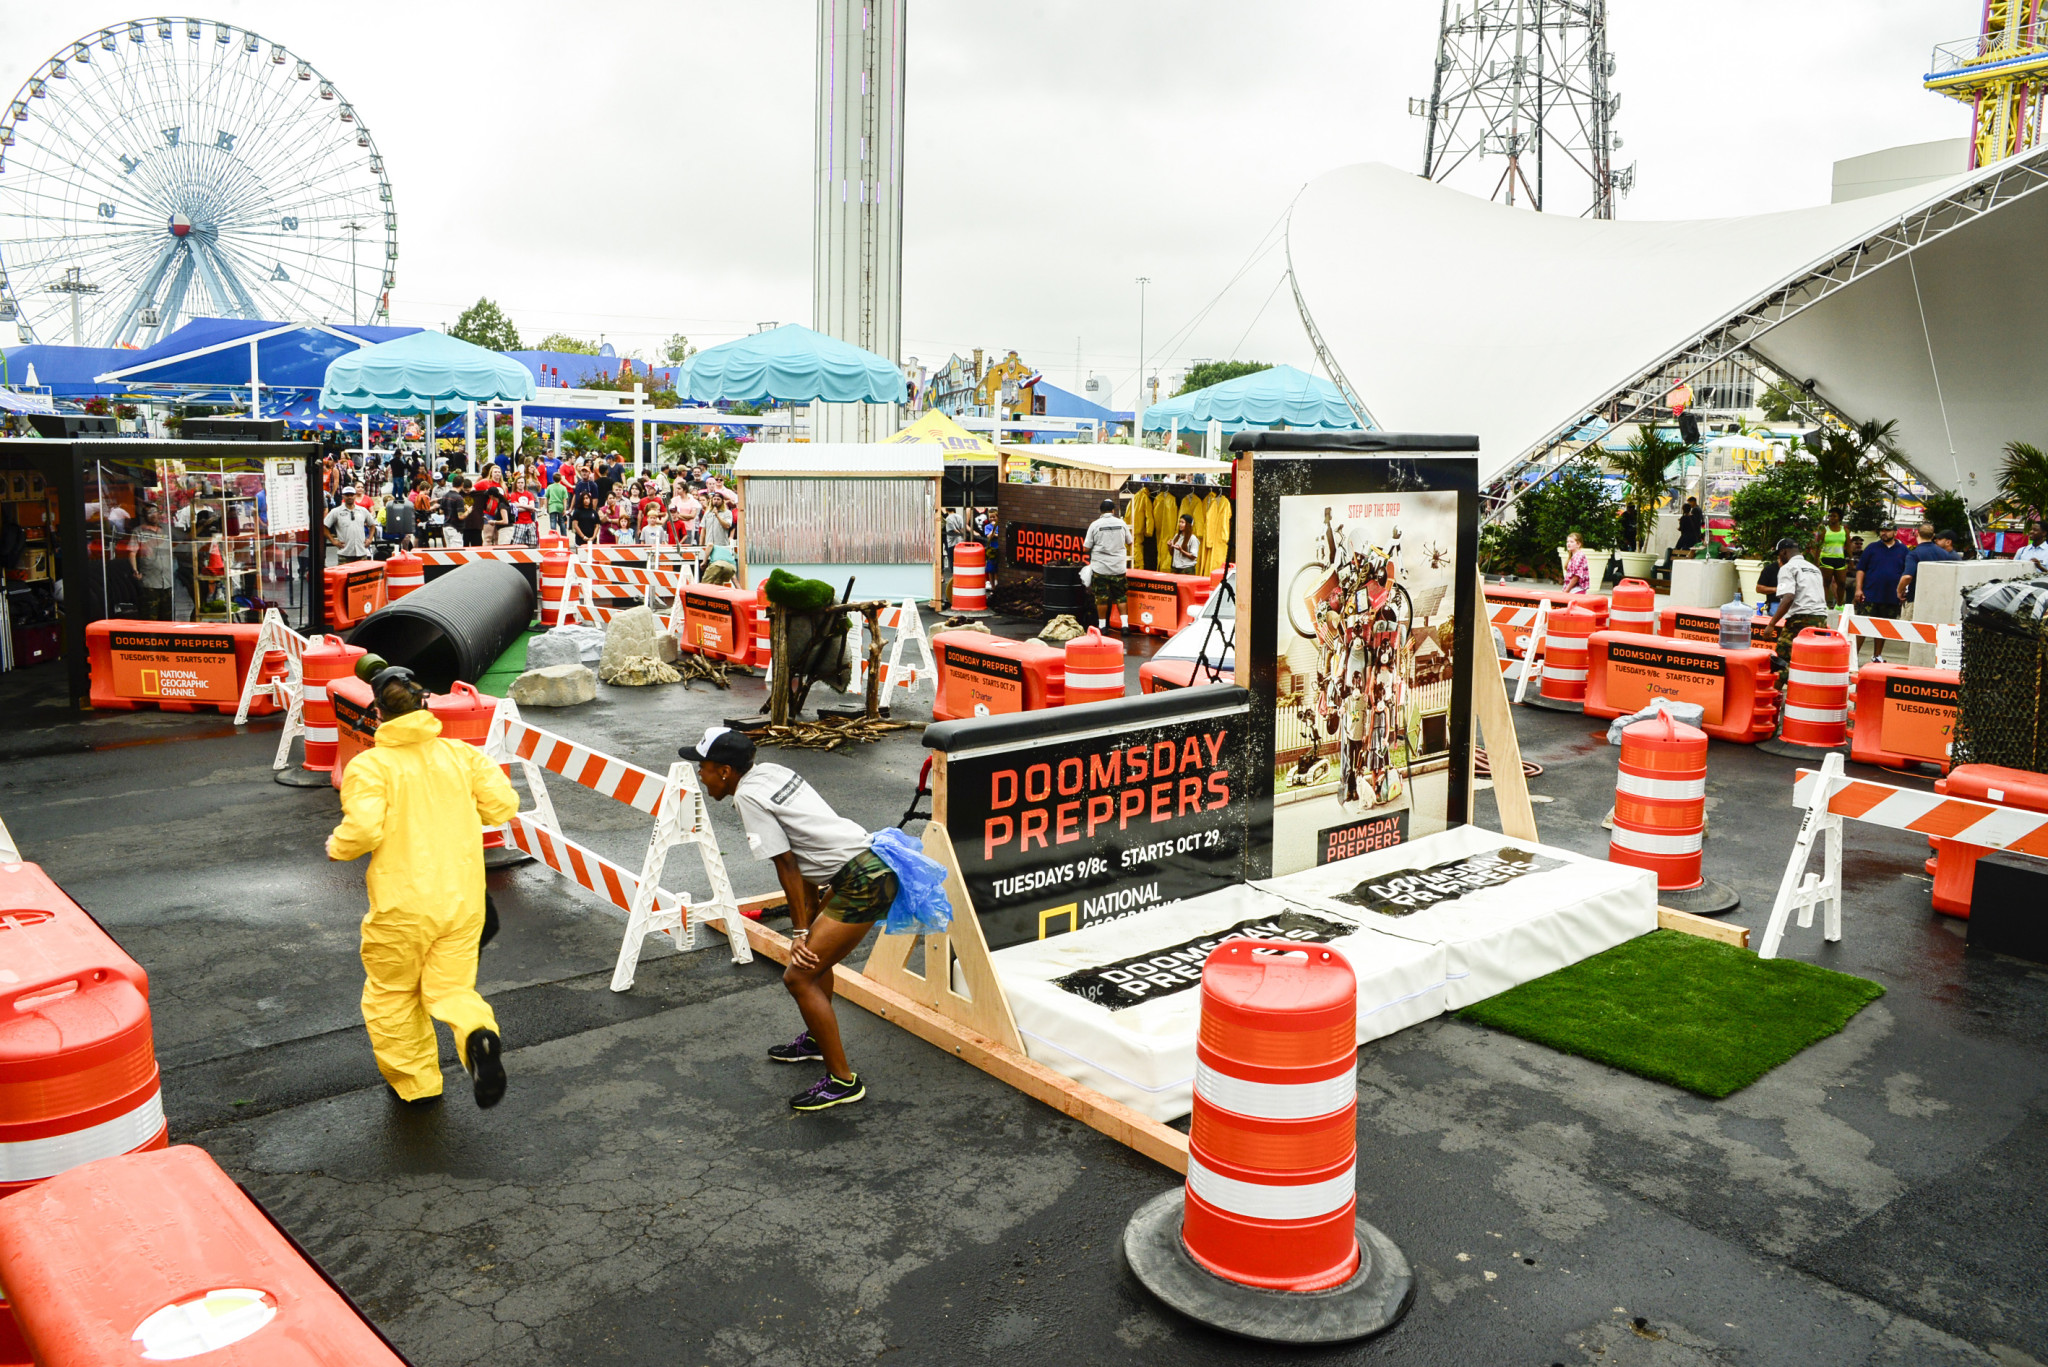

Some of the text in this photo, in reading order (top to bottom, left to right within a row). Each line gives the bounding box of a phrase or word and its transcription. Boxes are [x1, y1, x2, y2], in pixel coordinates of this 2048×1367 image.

[1348, 502, 1400, 518] STEP UP THE PREP
[1679, 618, 1720, 630] DOOMSDA
[116, 637, 229, 648] DOOMSDAY PREPPERS
[120, 654, 154, 662] TUESDAYS
[156, 655, 170, 663] 9/8c
[948, 651, 1018, 675] DOOMSDAY PREPPERS
[1613, 647, 1720, 670] DOOMSDAY PREPPERS
[160, 670, 198, 680] NATIONAL
[982, 678, 1000, 688] STARTS
[1615, 665, 1646, 676] TUESDAYS
[1666, 672, 1691, 683] STARTS
[1692, 676, 1705, 685] OCT
[1706, 678, 1715, 686] 29
[160, 679, 209, 689] GEOGRAPHIC
[1654, 685, 1679, 696] Charter
[1893, 683, 1958, 700] DOOMSDA
[161, 688, 197, 697] CHANNEL
[1896, 703, 1957, 719] TUESDAYS 9/8
[991, 730, 1227, 810] DOOMSDAY
[984, 770, 1230, 861] PREPPERS
[1329, 816, 1400, 846] DOOMSDAY
[1327, 830, 1401, 863] PREPPERS
[992, 829, 1220, 899] TUESDAYS 9/8c STARTS OCT 29
[1083, 882, 1162, 920] NATIONAL
